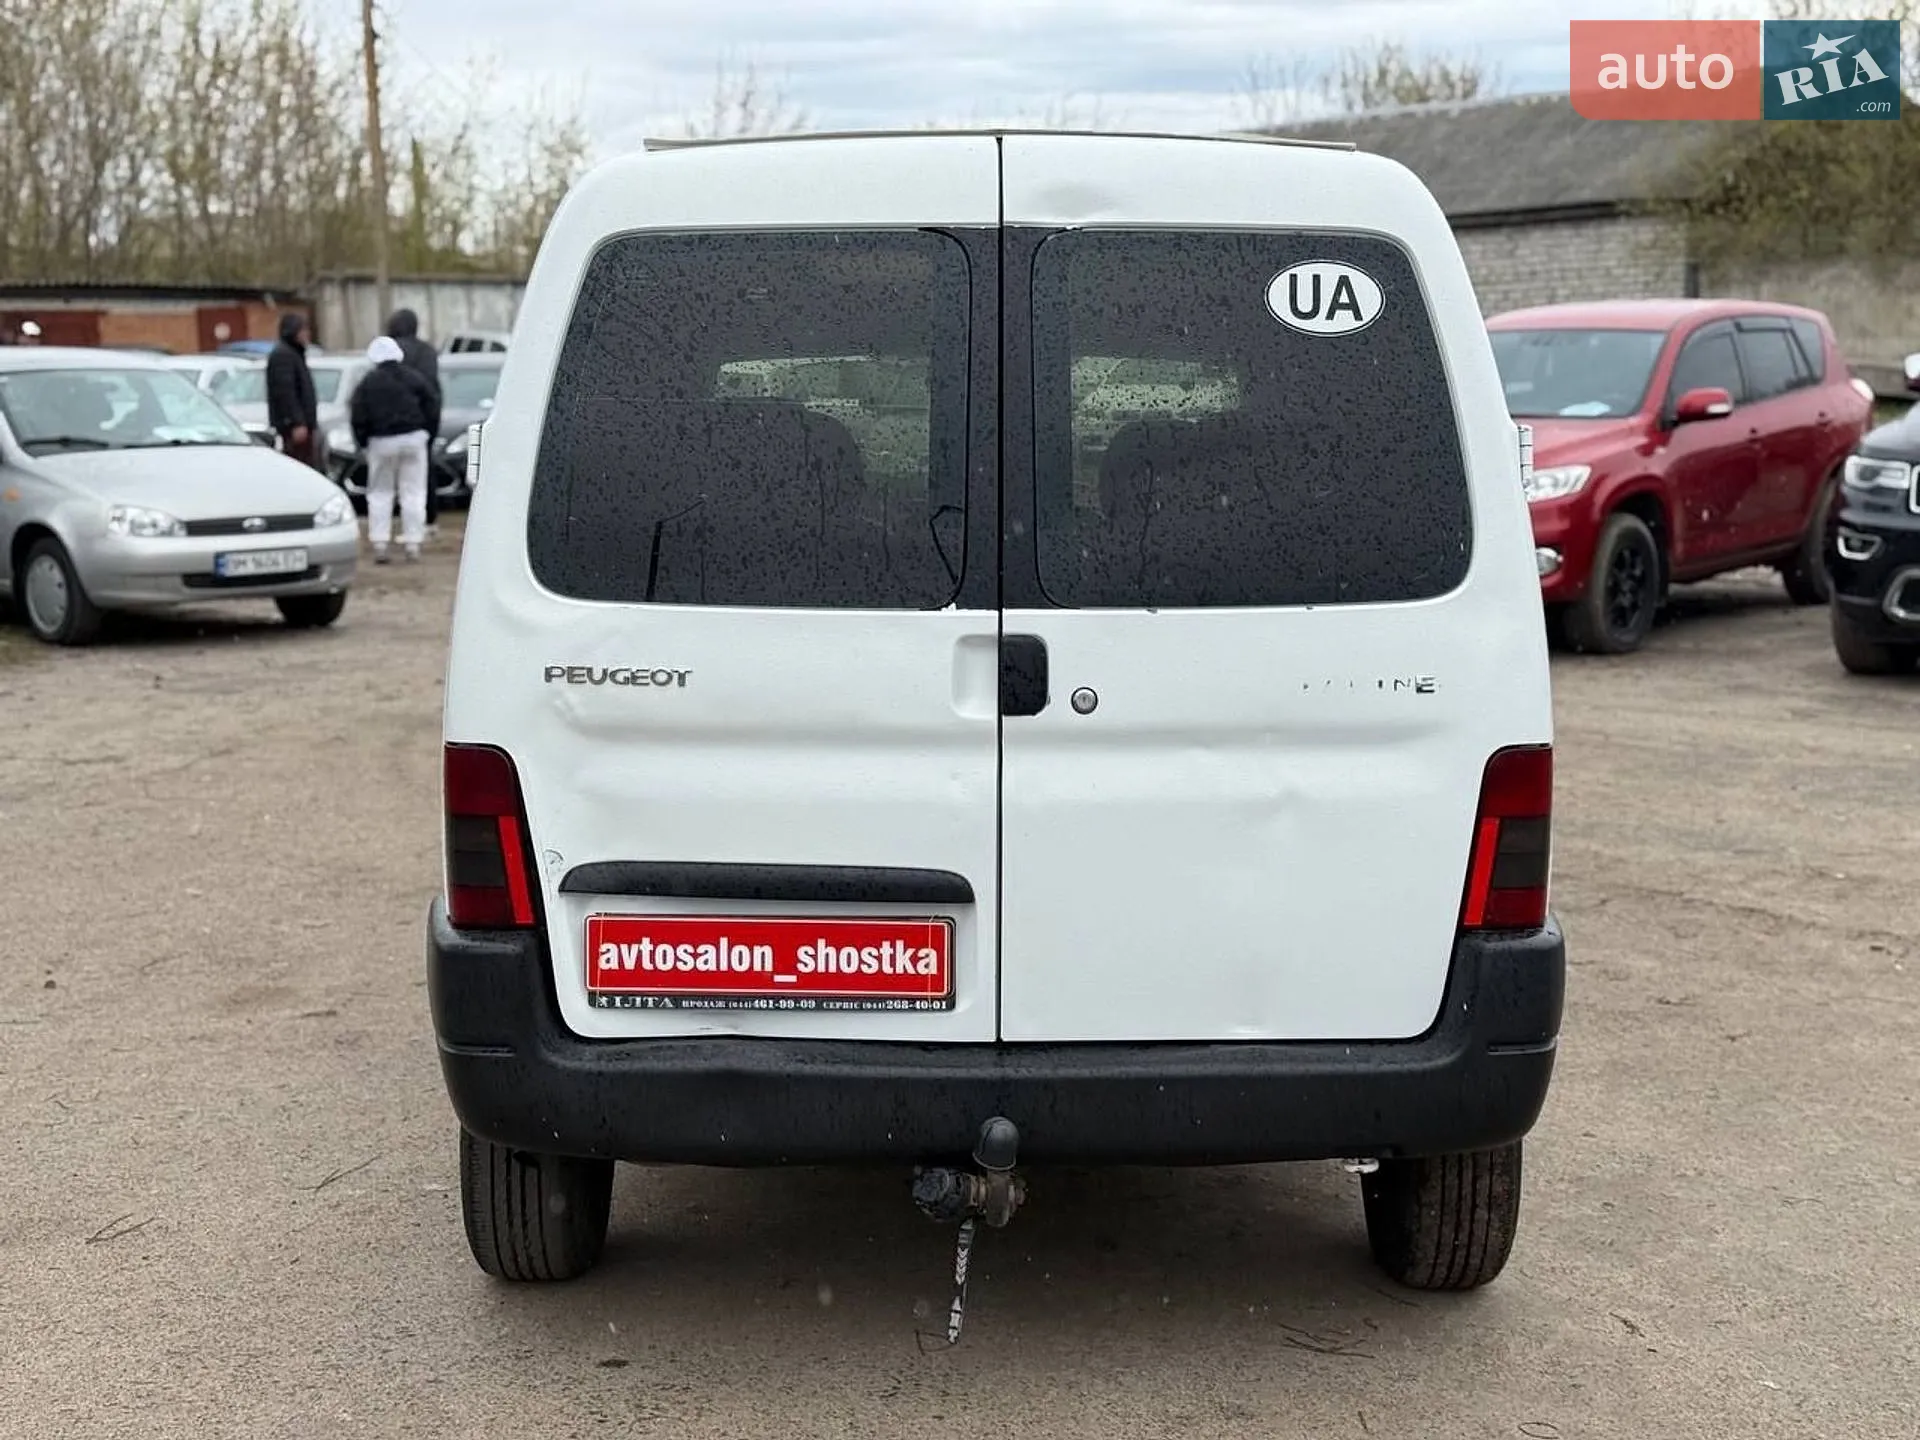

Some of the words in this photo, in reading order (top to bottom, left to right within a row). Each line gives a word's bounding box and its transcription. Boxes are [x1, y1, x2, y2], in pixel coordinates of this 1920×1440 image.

[1289, 273, 1363, 321] UA
[544, 665, 693, 688] PEUGEOT
[599, 936, 938, 983] avtosalon_shostka
